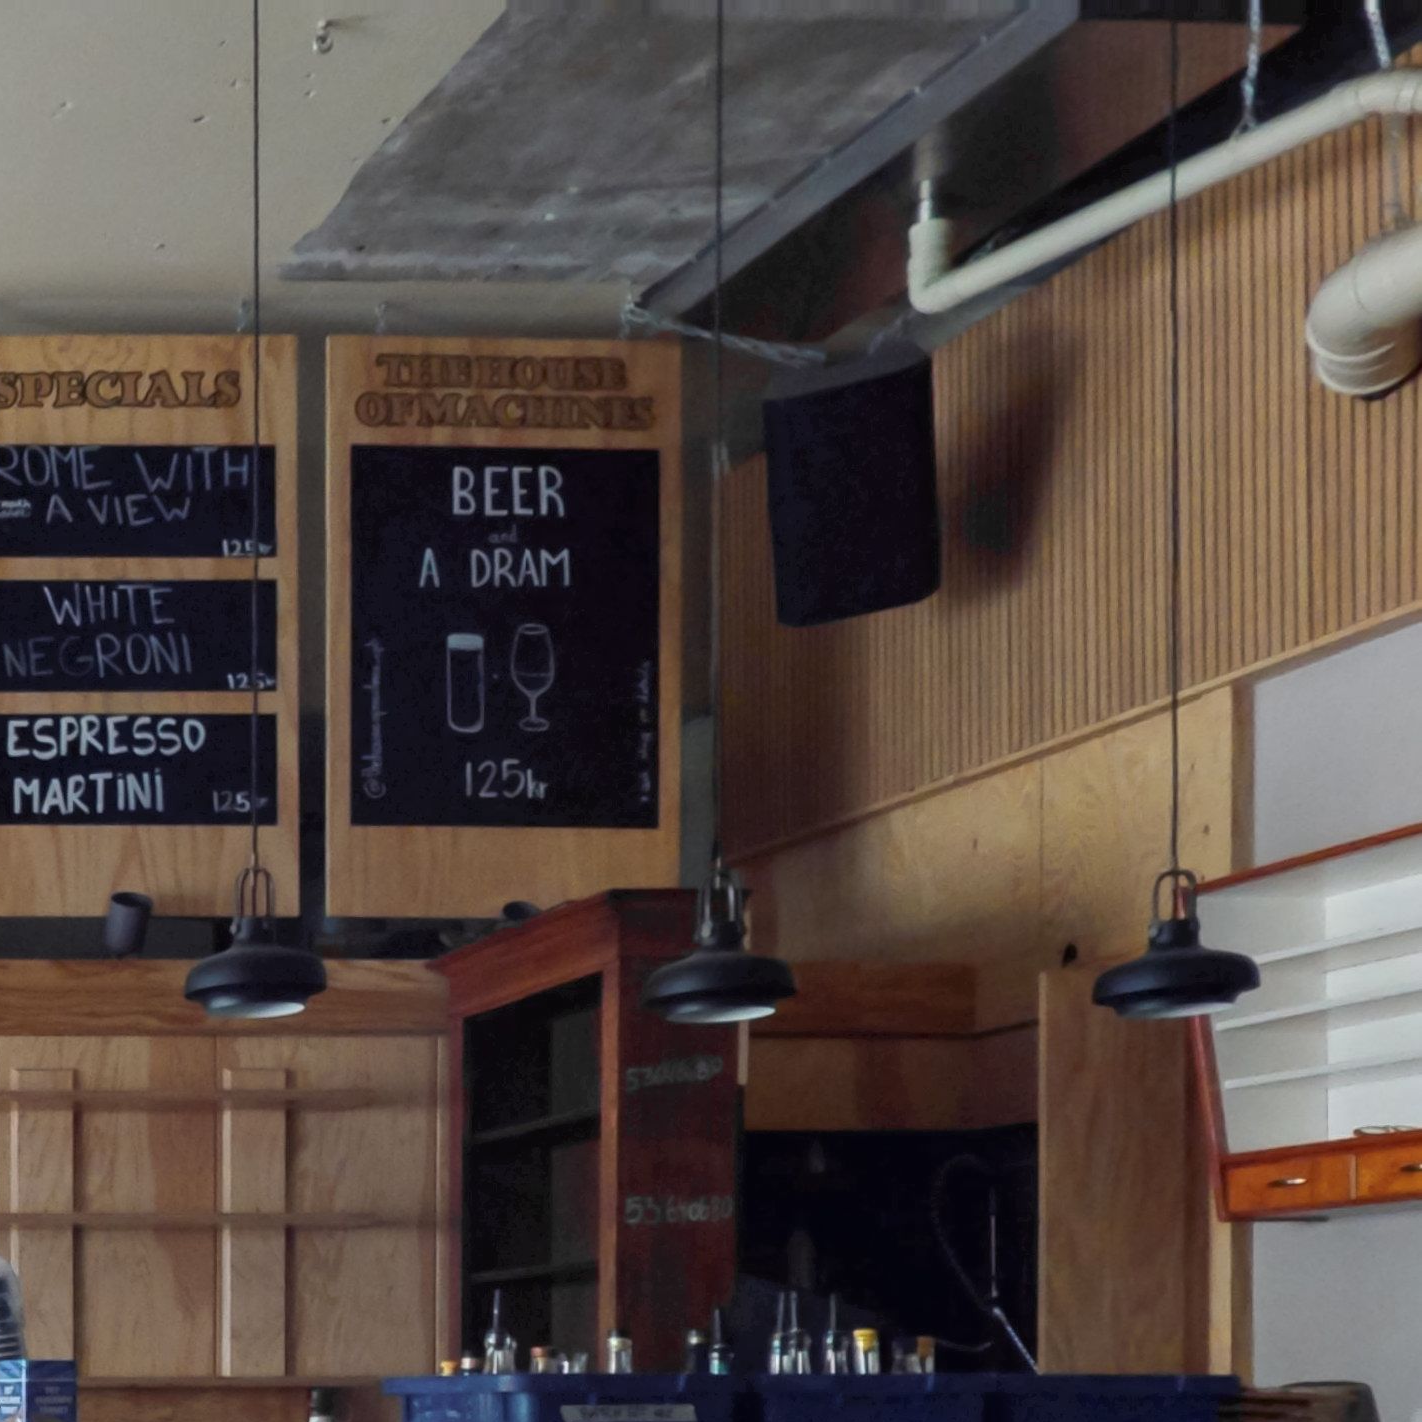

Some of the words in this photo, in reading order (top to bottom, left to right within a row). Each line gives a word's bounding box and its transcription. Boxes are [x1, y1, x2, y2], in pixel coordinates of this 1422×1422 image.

[474, 356, 627, 391] HOUSE
[416, 392, 655, 432] MACHINES
[135, 446, 250, 492] WITH
[452, 465, 566, 518] BEER
[45, 494, 73, 525] A
[87, 494, 191, 527] VIEW
[419, 548, 441, 588] A
[470, 548, 572, 588] DRAM
[43, 582, 176, 627] WHITE
[3, 632, 193, 679] NEGRONI
[6, 715, 206, 760] ESPRESSO
[13, 768, 165, 815] MARTINI
[465, 758, 549, 799] 125kr
